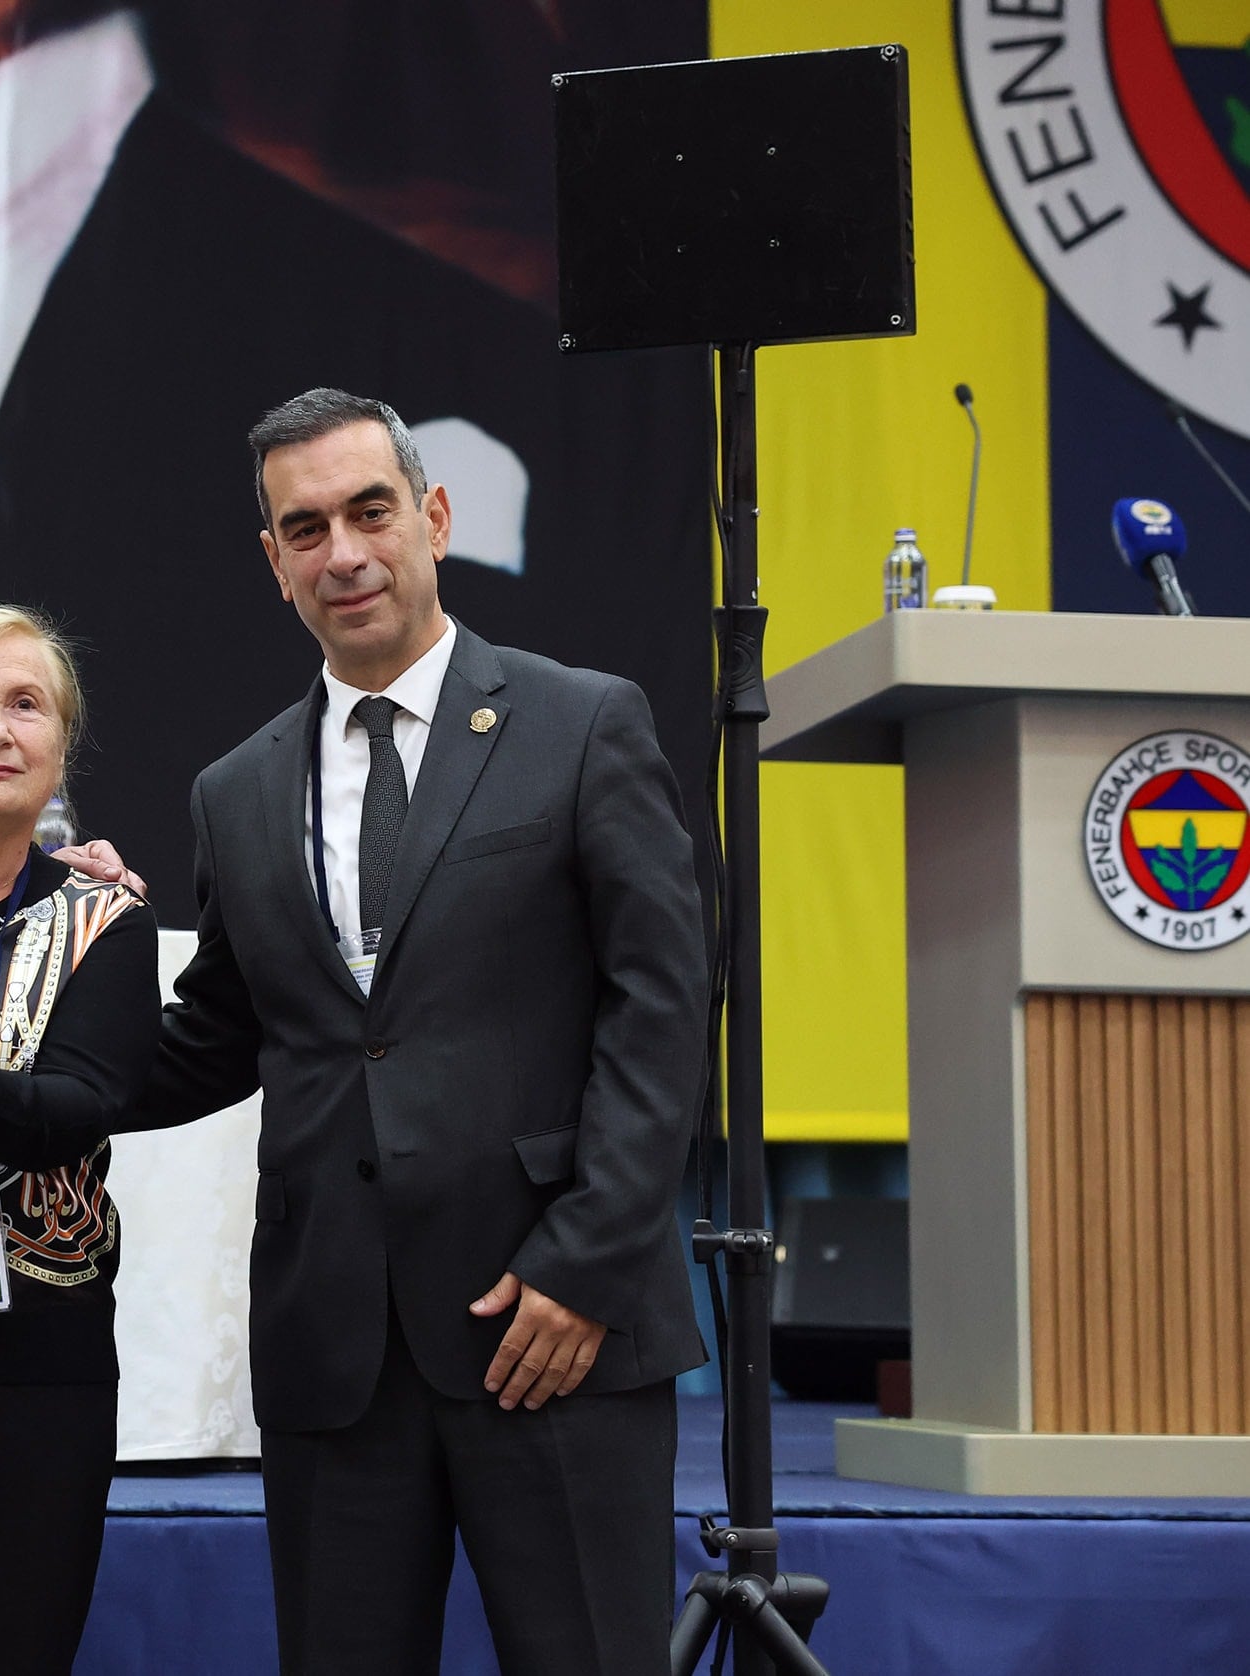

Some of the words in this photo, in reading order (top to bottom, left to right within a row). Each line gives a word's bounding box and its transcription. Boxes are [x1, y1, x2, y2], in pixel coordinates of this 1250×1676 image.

[1091, 740, 1173, 900] FENERBAHÇE
[1184, 738, 1250, 787] SPOR
[1160, 916, 1217, 942] 1907
